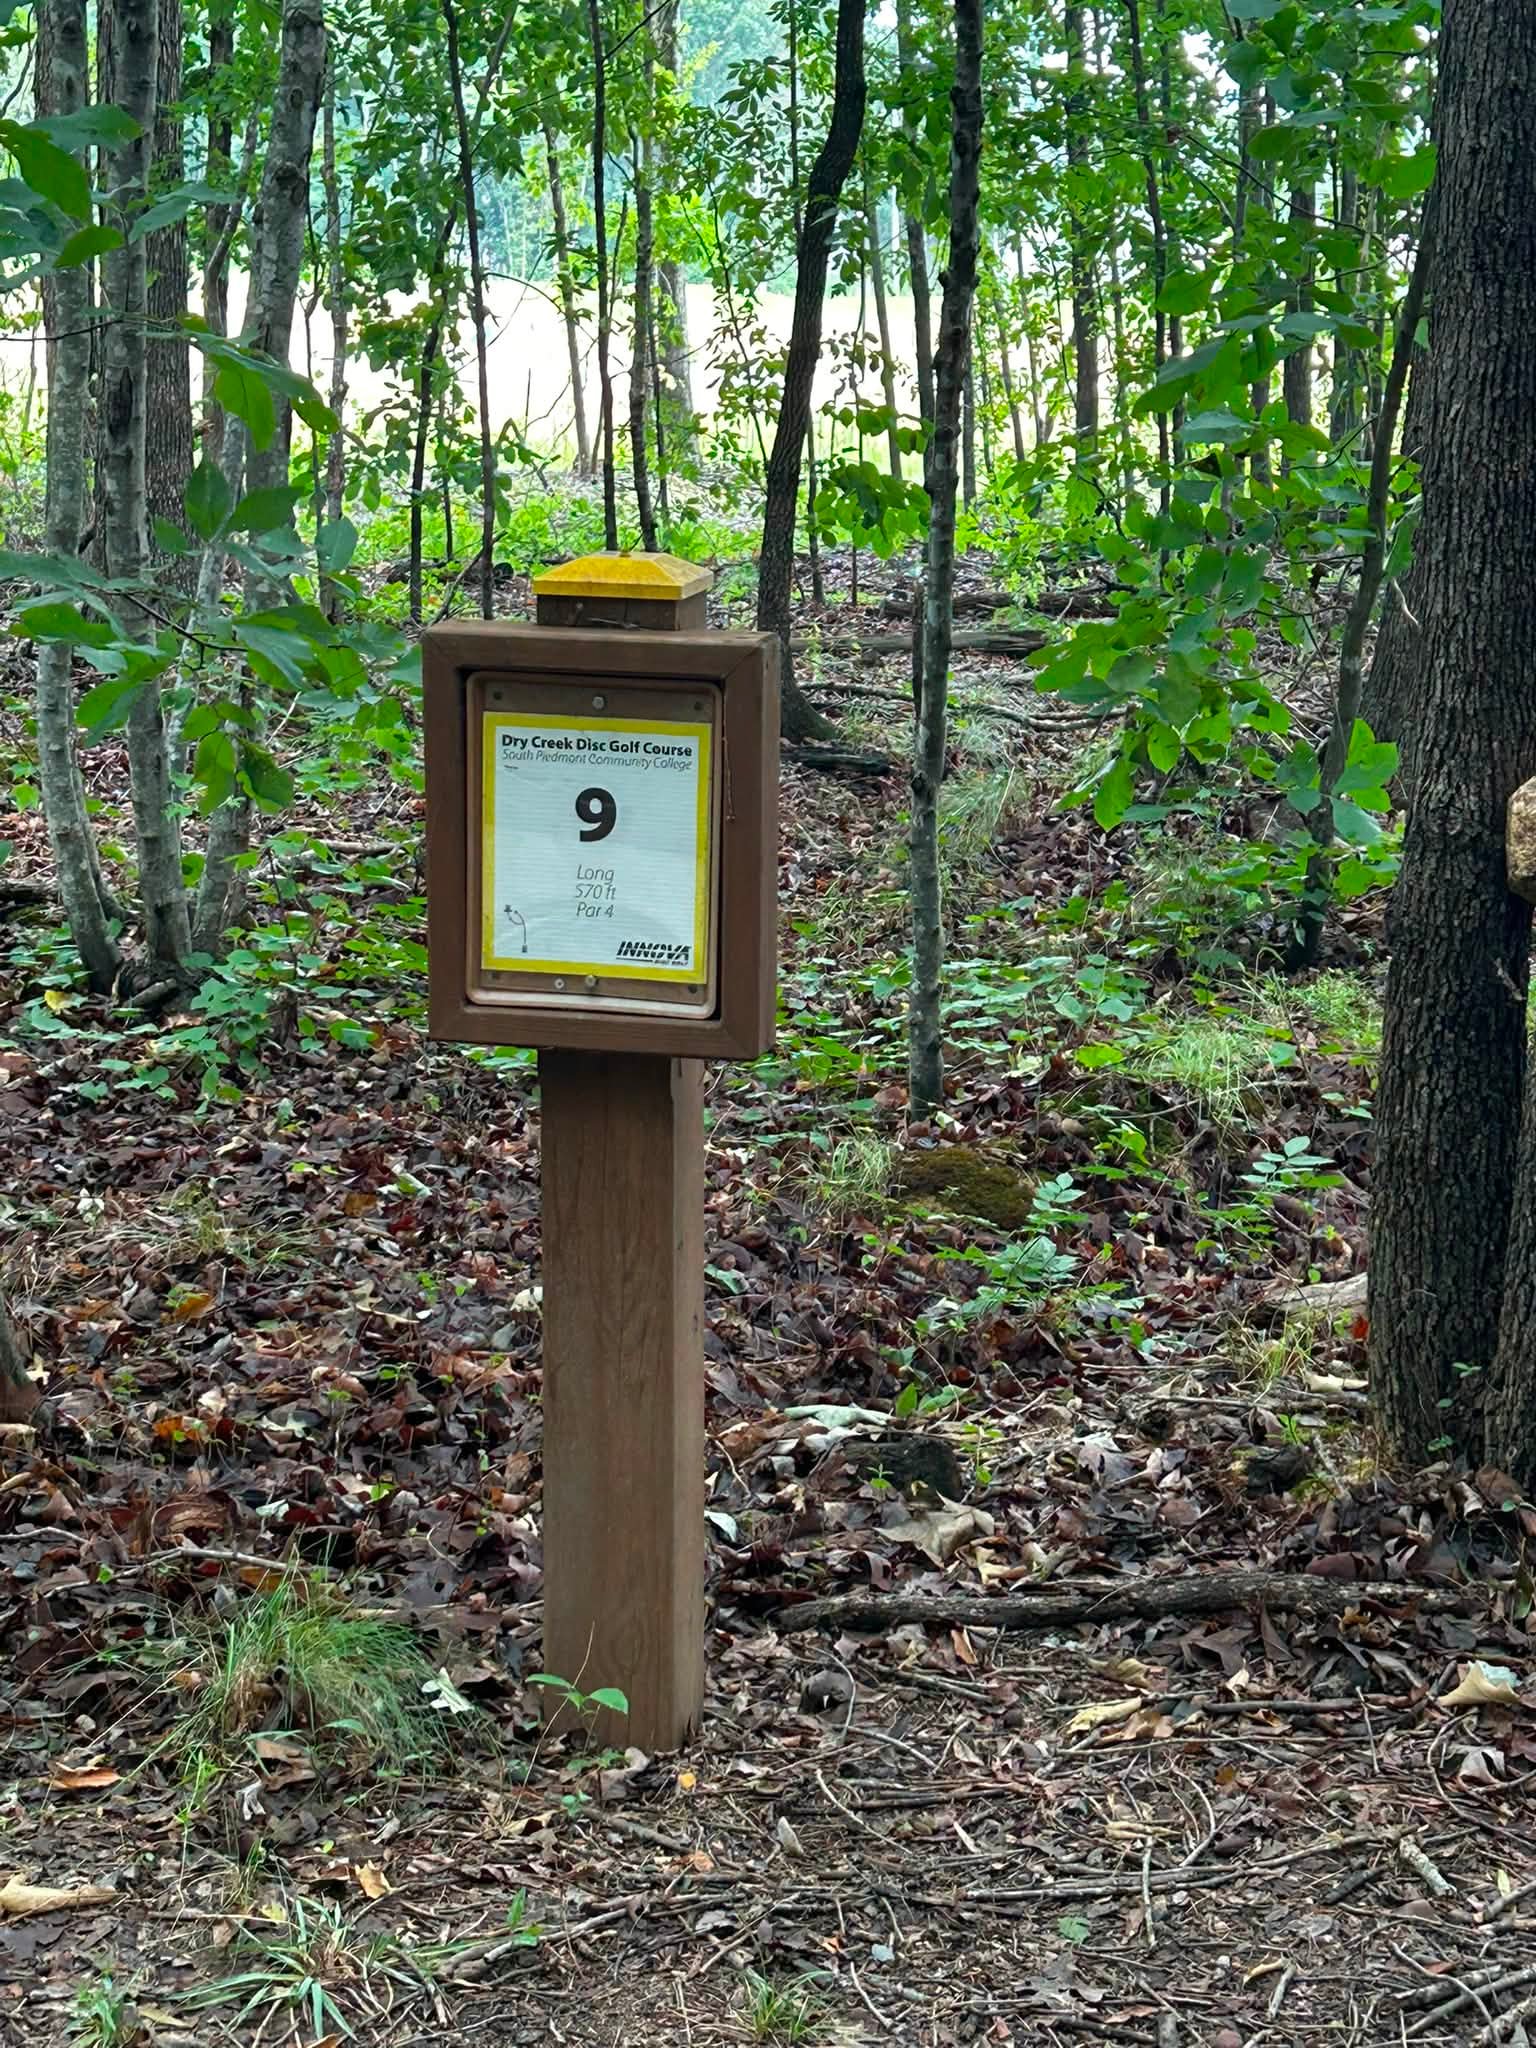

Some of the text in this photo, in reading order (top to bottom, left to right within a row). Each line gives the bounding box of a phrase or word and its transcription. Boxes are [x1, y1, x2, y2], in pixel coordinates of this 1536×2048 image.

[502, 734, 692, 756] Dry Creek Disc Golf Course
[503, 748, 692, 772] South Piedmont Community College
[575, 787, 617, 842] 9
[577, 864, 615, 885] Long
[575, 883, 616, 900] 570 ft
[576, 901, 615, 918] Par 4
[616, 941, 692, 960] INNOVA
